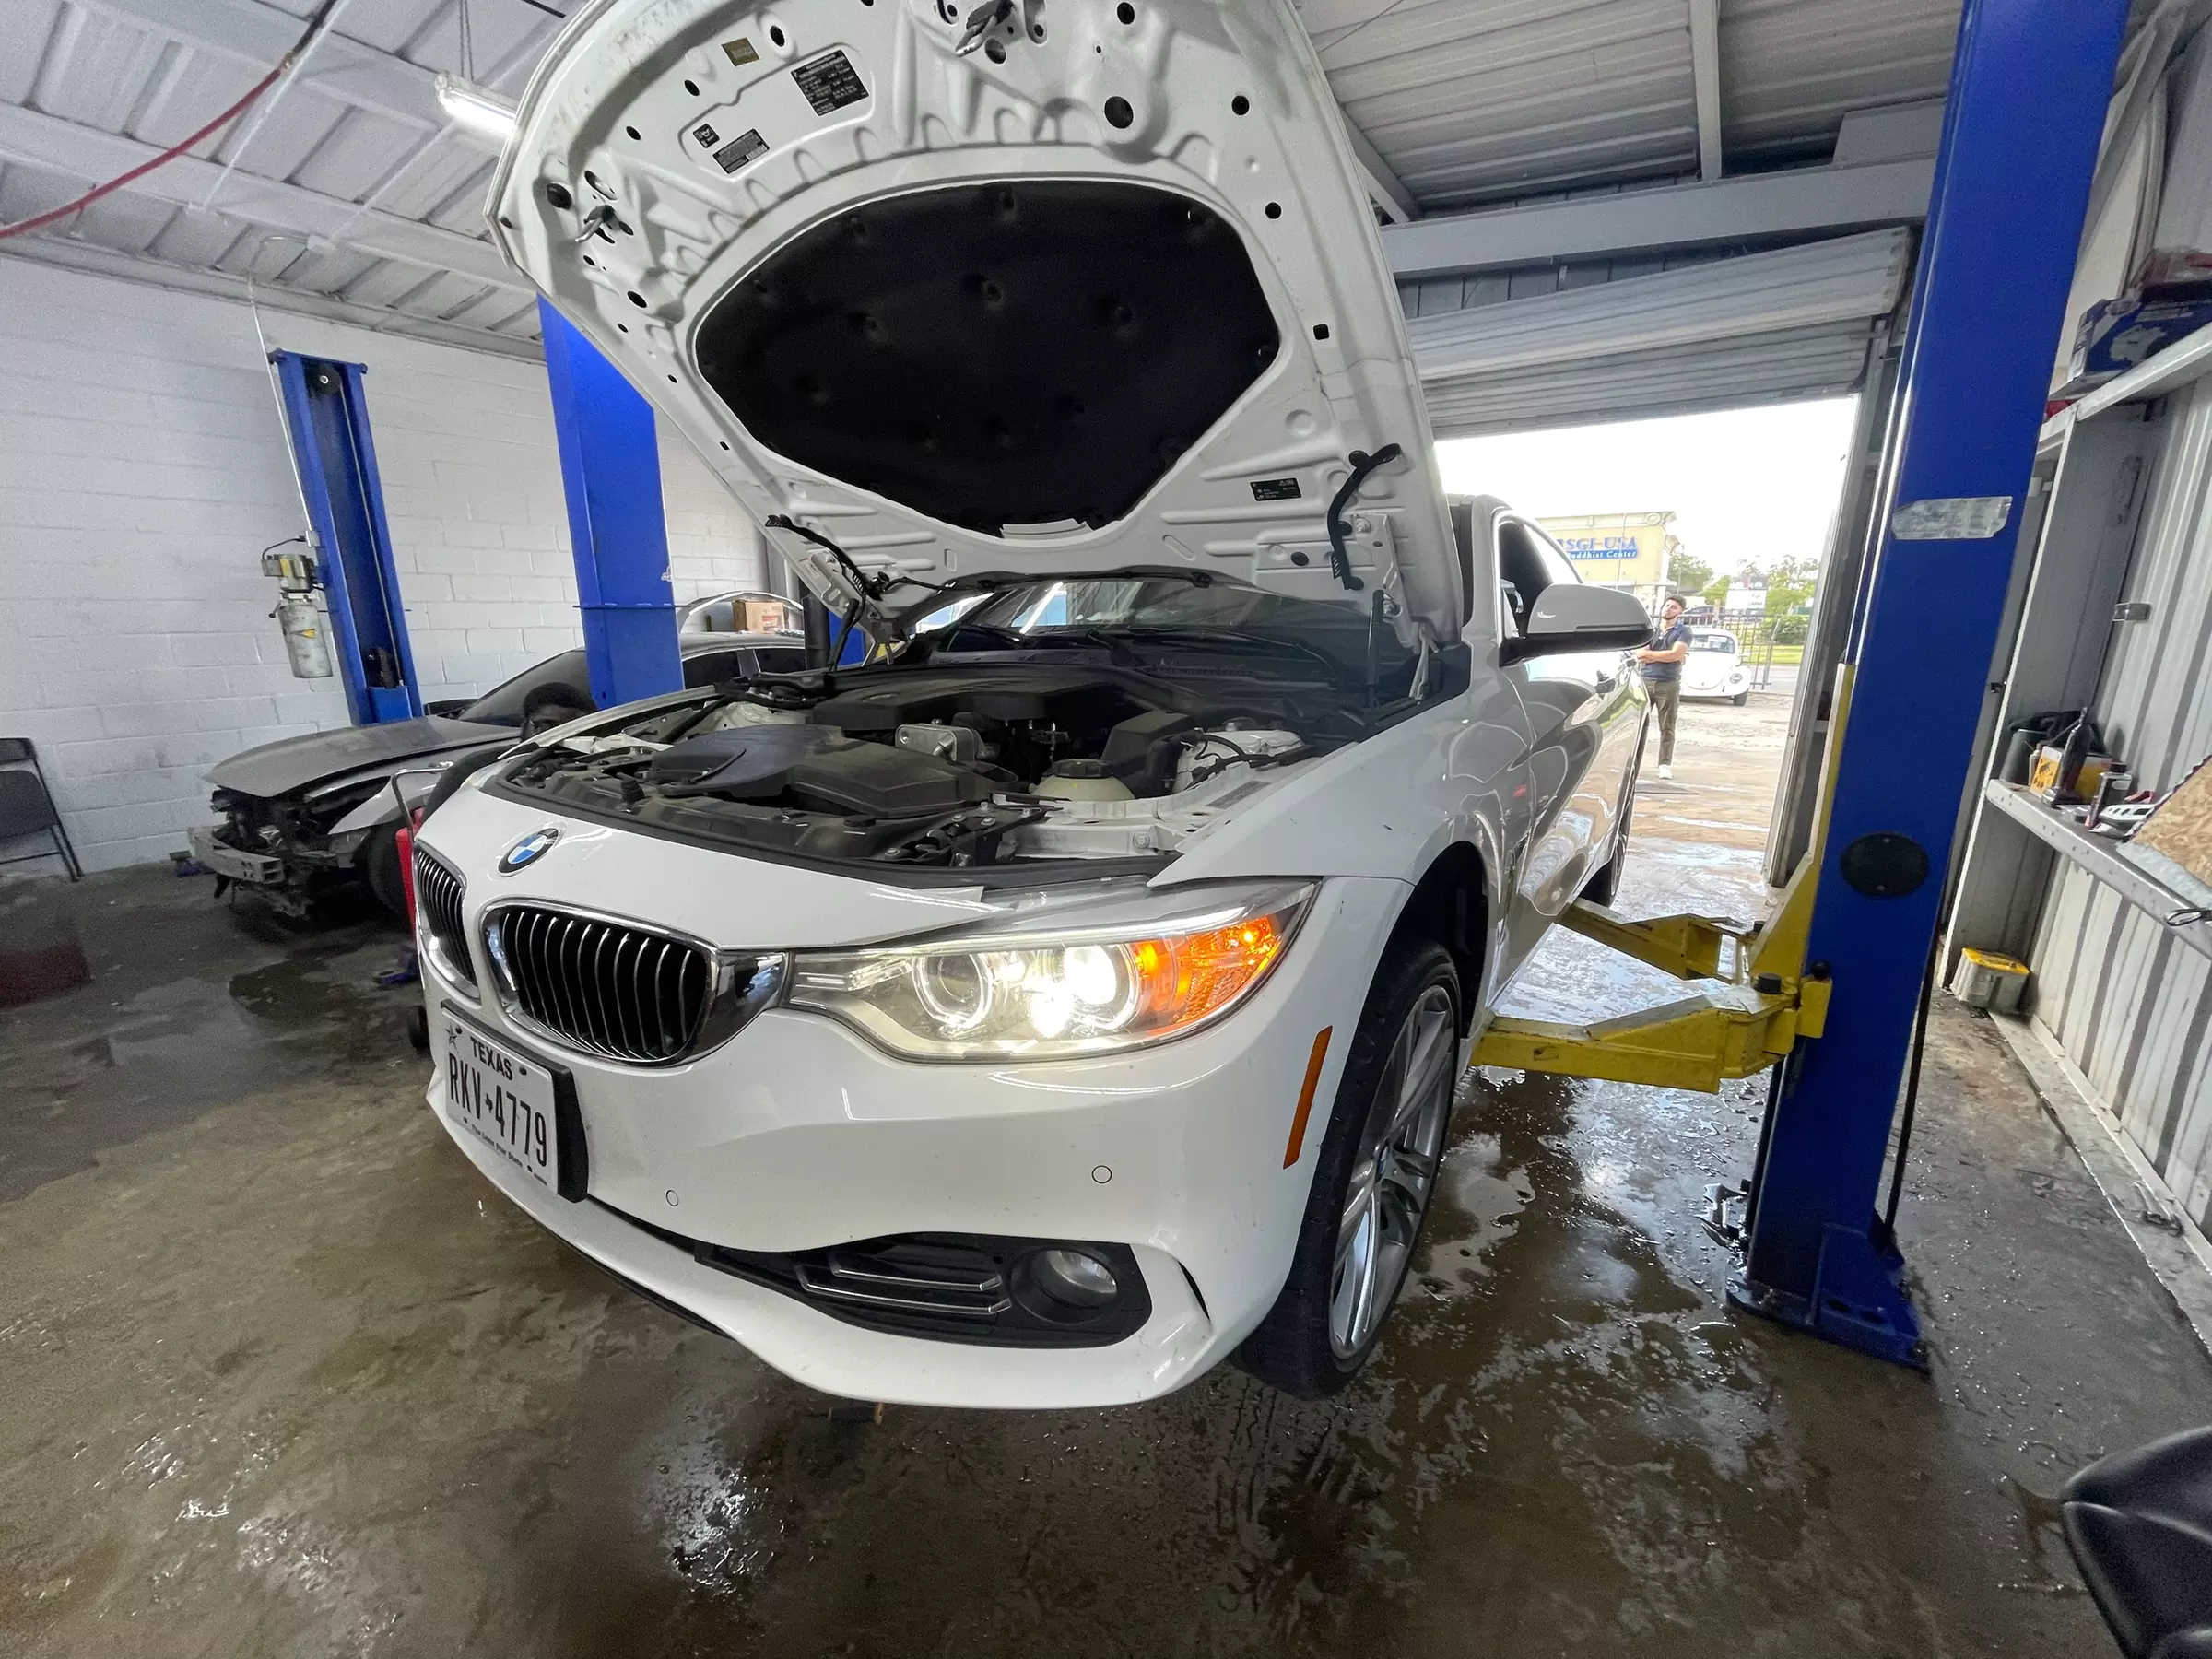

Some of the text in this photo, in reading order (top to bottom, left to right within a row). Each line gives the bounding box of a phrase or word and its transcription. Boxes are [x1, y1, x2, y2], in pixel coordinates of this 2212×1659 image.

[1566, 536, 1637, 550] SGI-USA
[1569, 549, 1637, 559] uddhist Center
[470, 1036, 513, 1081] TEXAS
